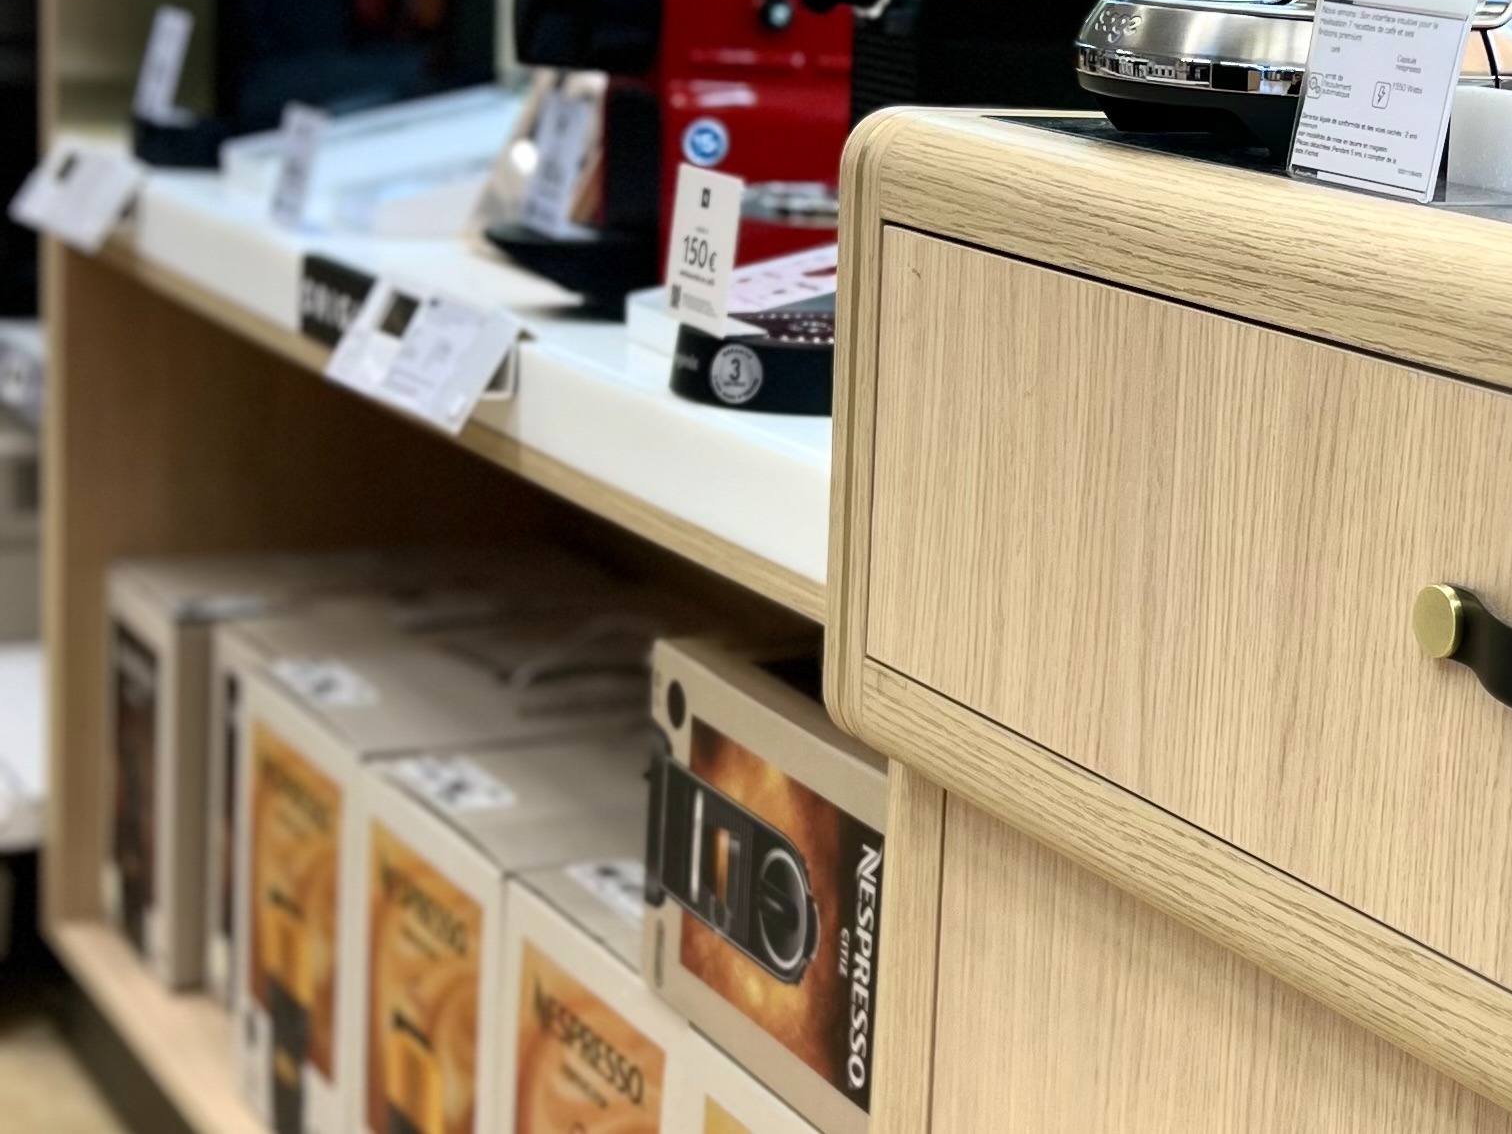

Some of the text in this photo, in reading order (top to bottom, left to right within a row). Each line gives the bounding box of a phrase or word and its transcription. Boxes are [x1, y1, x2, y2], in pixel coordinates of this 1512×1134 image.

[728, 357, 742, 382] 3
[837, 926, 850, 979] CITIZ
[847, 843, 885, 1091] NESPRESSO
[533, 970, 646, 1106] NESPRESSO
